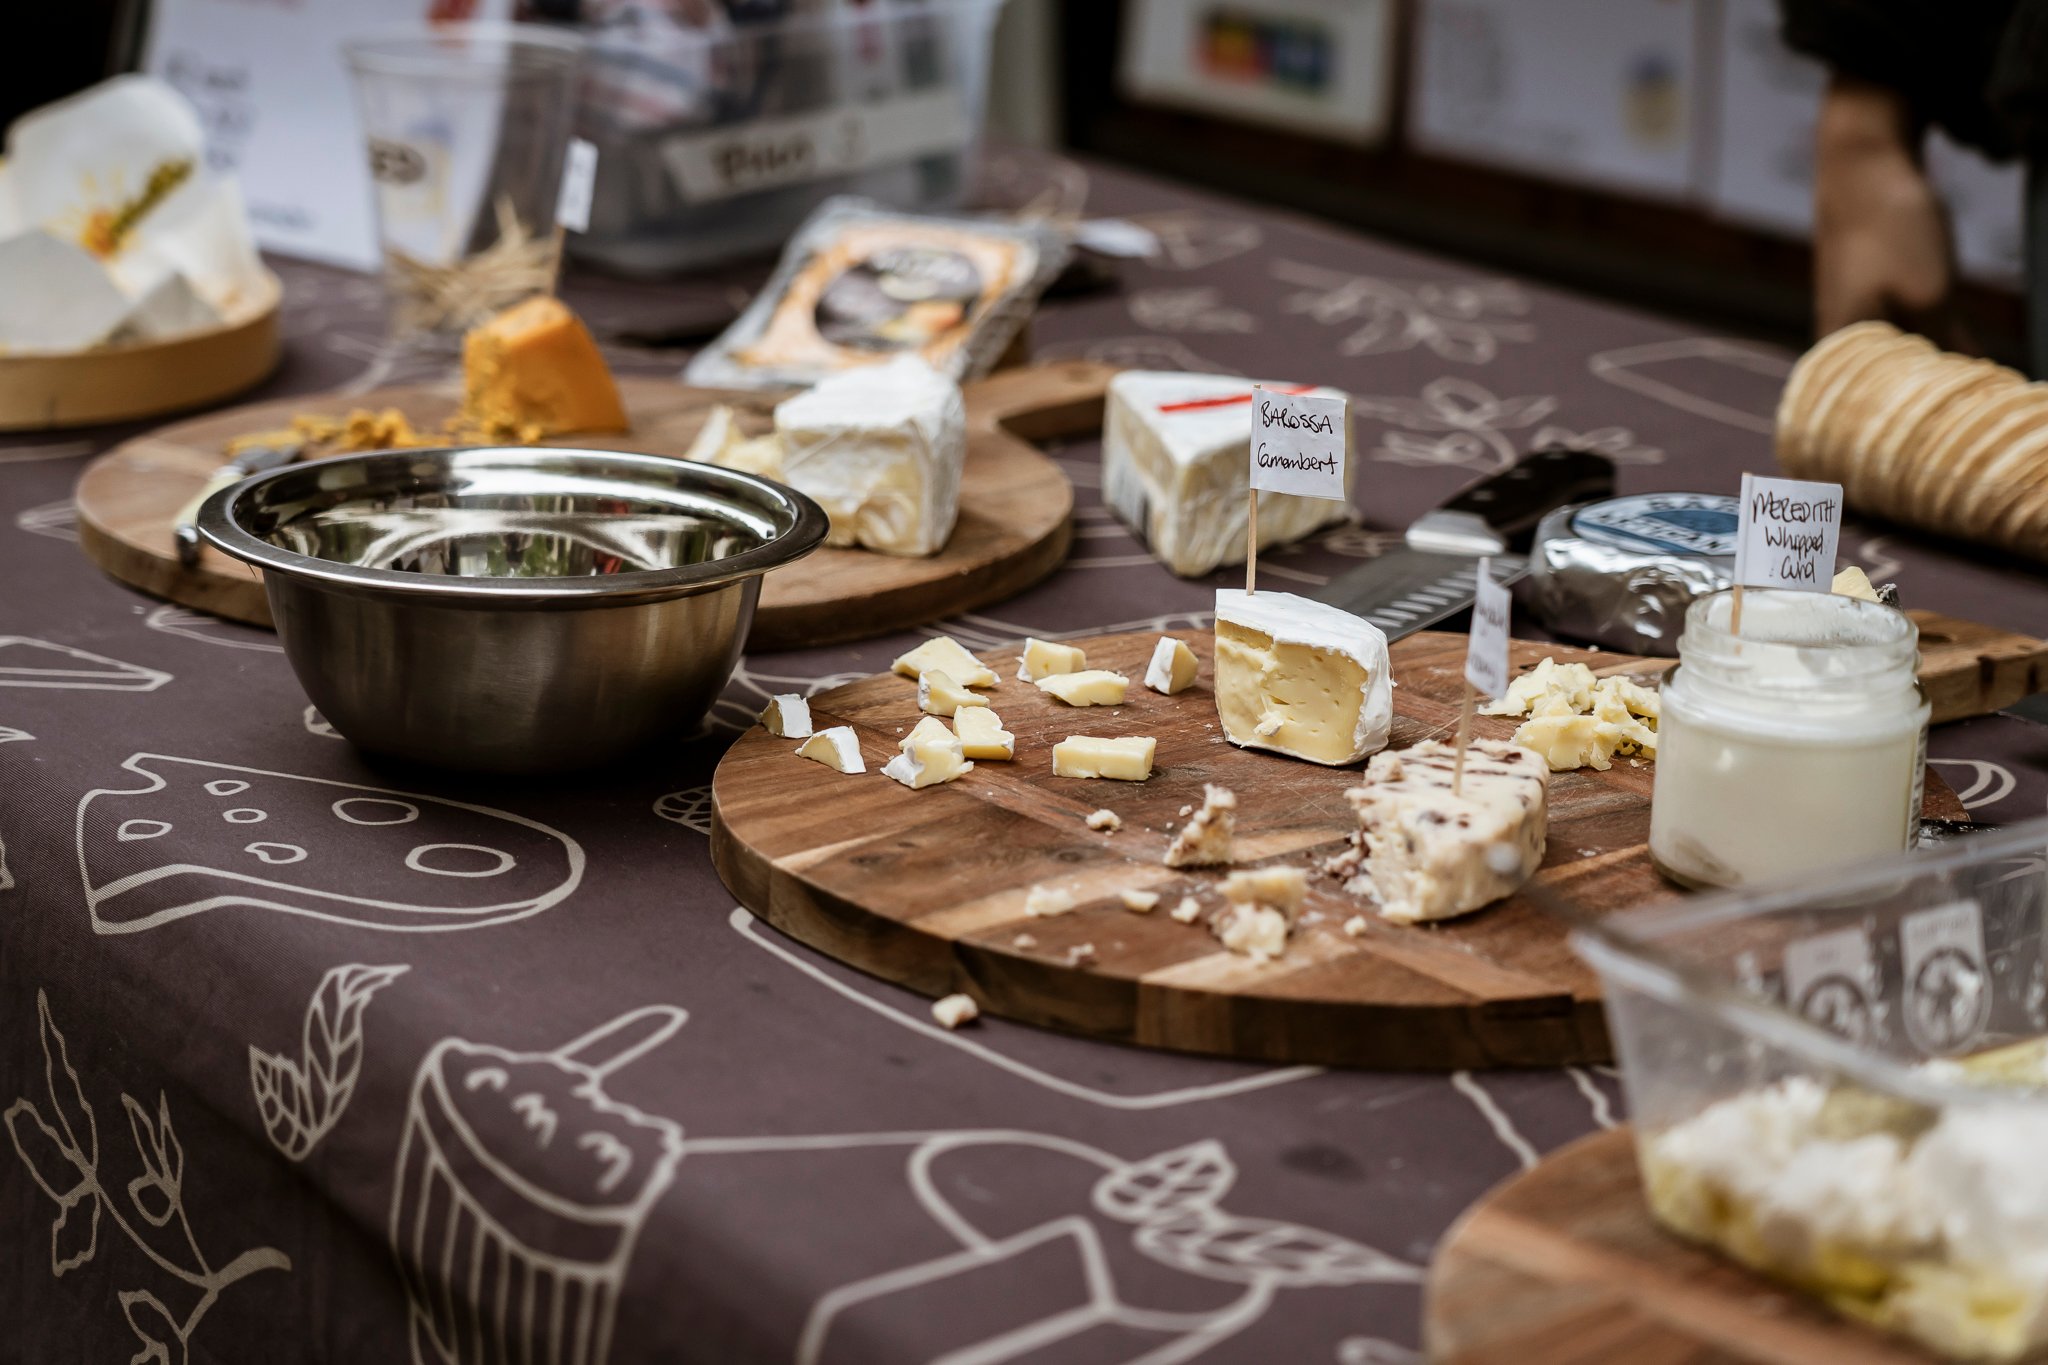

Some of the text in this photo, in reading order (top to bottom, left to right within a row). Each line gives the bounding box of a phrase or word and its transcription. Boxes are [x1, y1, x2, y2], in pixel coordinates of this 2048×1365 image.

[1260, 400, 1334, 434] BAROSSA
[1257, 442, 1339, 475] Camembert
[1752, 490, 1836, 523] MEREDITH
[1765, 526, 1824, 560] Whipped
[1780, 555, 1816, 583] Curd
